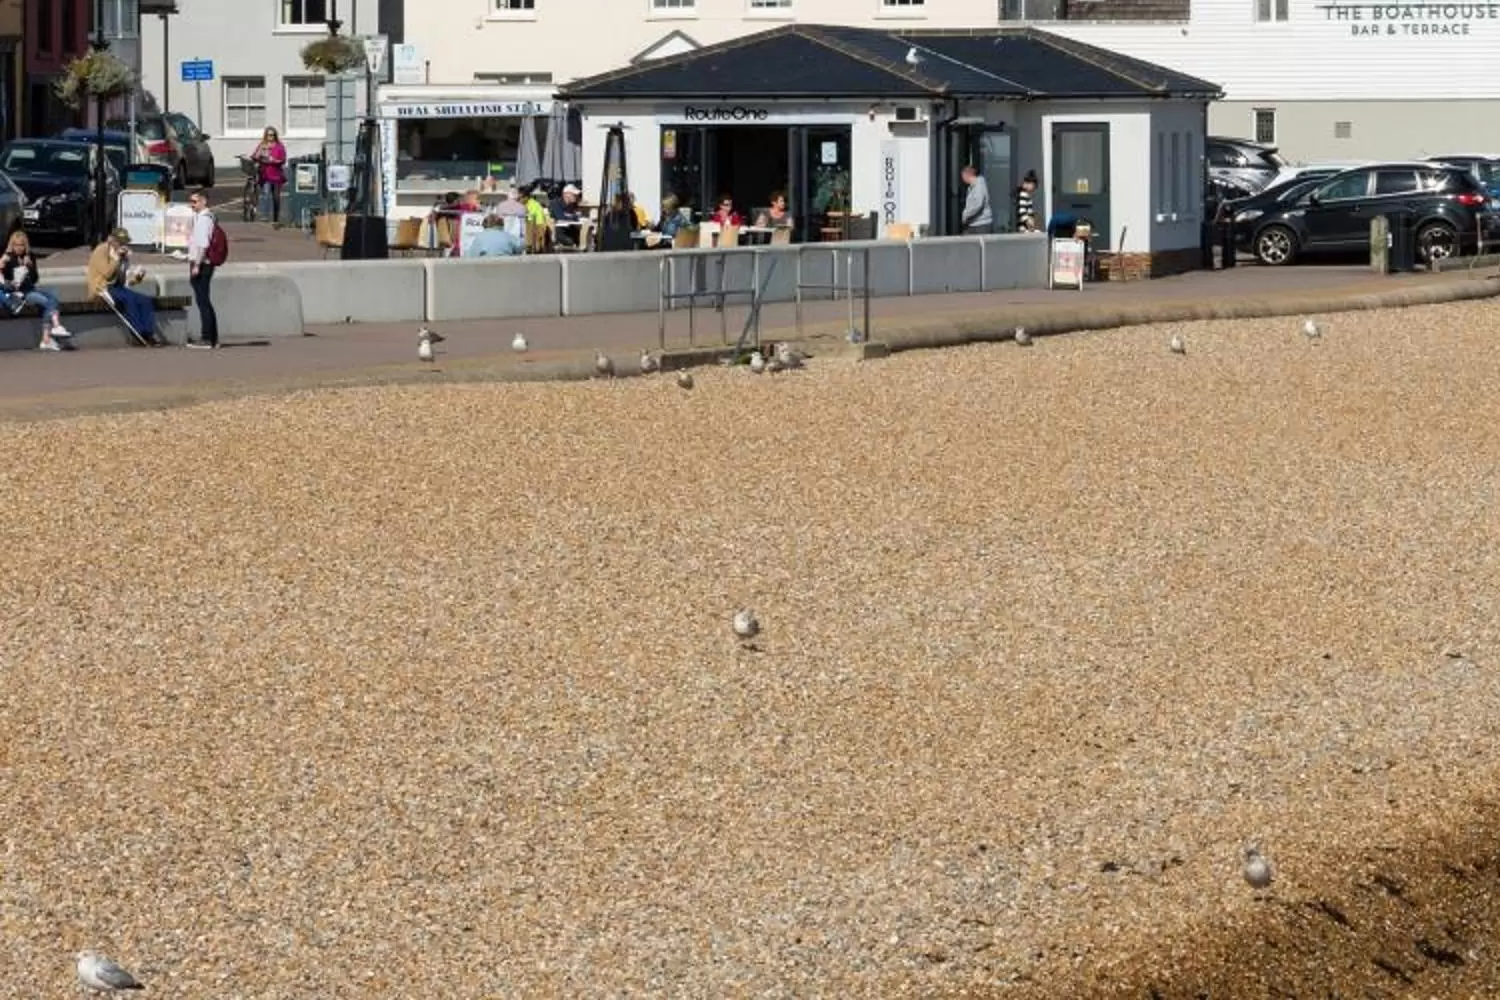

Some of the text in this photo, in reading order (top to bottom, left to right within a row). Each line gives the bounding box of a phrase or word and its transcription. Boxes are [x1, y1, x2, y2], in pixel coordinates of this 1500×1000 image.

[1325, 4, 1499, 21] THE BOATHOUSE
[1351, 23, 1471, 36] BAR & TERRACE
[684, 105, 769, 121] RouteOne
